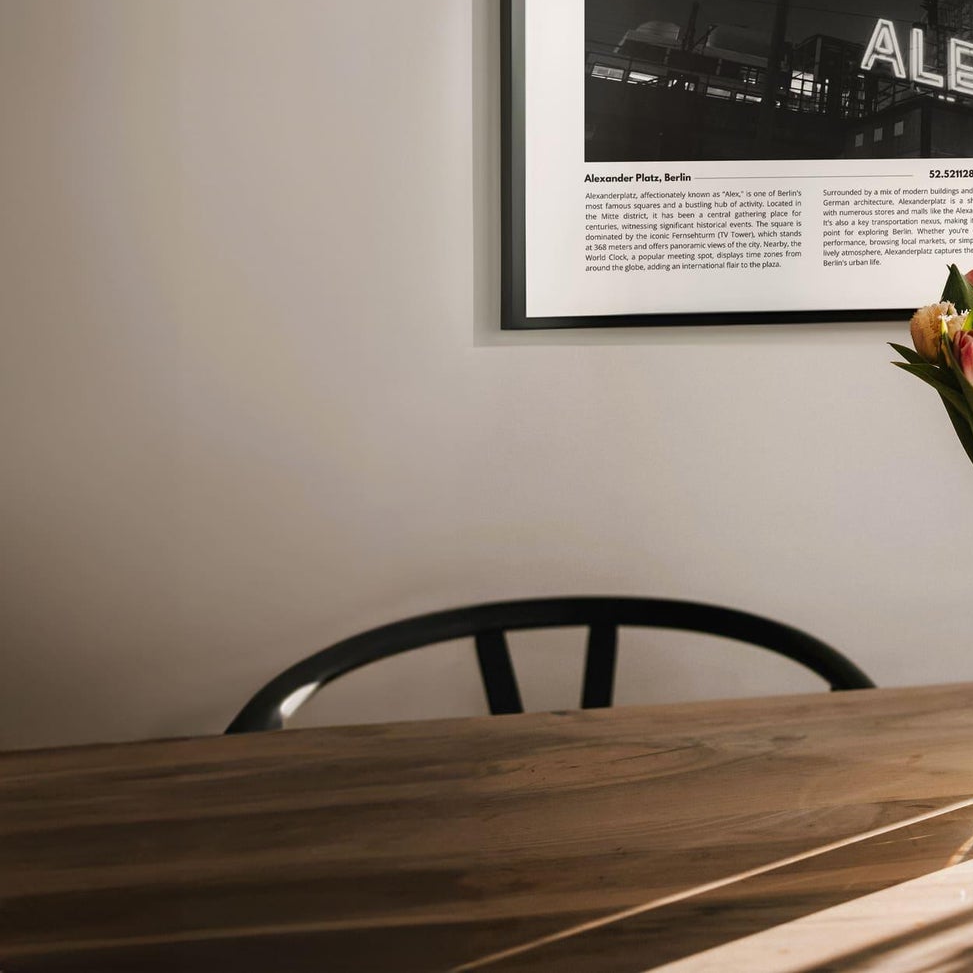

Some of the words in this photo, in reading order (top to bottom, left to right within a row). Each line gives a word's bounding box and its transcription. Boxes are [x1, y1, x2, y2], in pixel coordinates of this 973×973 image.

[584, 173, 634, 182] Alexander
[636, 173, 662, 183] Platz,
[664, 173, 691, 181] Berlin
[585, 192, 638, 201] Alexanderplatz,
[640, 191, 686, 200] affectionately
[864, 189, 872, 197] by
[930, 188, 959, 196] buildings
[685, 201, 712, 210] bustling
[739, 200, 764, 209] activity.
[898, 198, 946, 206] Alexanderplatz
[734, 211, 767, 219] gathering
[770, 210, 788, 219] place
[943, 207, 954, 215] the
[621, 223, 658, 231] witnessing
[659, 221, 694, 231] significant
[696, 221, 727, 229] historical
[858, 219, 870, 227] key
[871, 218, 918, 227] transportation
[944, 217, 968, 225] making
[585, 233, 623, 241] dominated
[625, 233, 634, 241] by
[650, 232, 670, 240] iconic
[672, 231, 716, 239] Fernsehturm
[717, 231, 728, 239] (TV
[823, 229, 840, 237] point
[858, 229, 889, 237] exploring
[594, 243, 607, 251] 368
[648, 242, 669, 250] offers
[670, 242, 706, 251] panoramic
[748, 241, 762, 249] city.
[763, 241, 789, 249] Nearby,
[823, 239, 868, 248] performance,
[638, 253, 665, 262] popular
[667, 253, 695, 261] meeting
[716, 251, 744, 260] displays
[823, 249, 840, 258] lively
[841, 249, 882, 257] atmosphere,
[884, 248, 932, 256] Alexanderplatz
[624, 263, 646, 272] globe,
[647, 263, 671, 271] adding
[762, 261, 781, 269] plaza.
